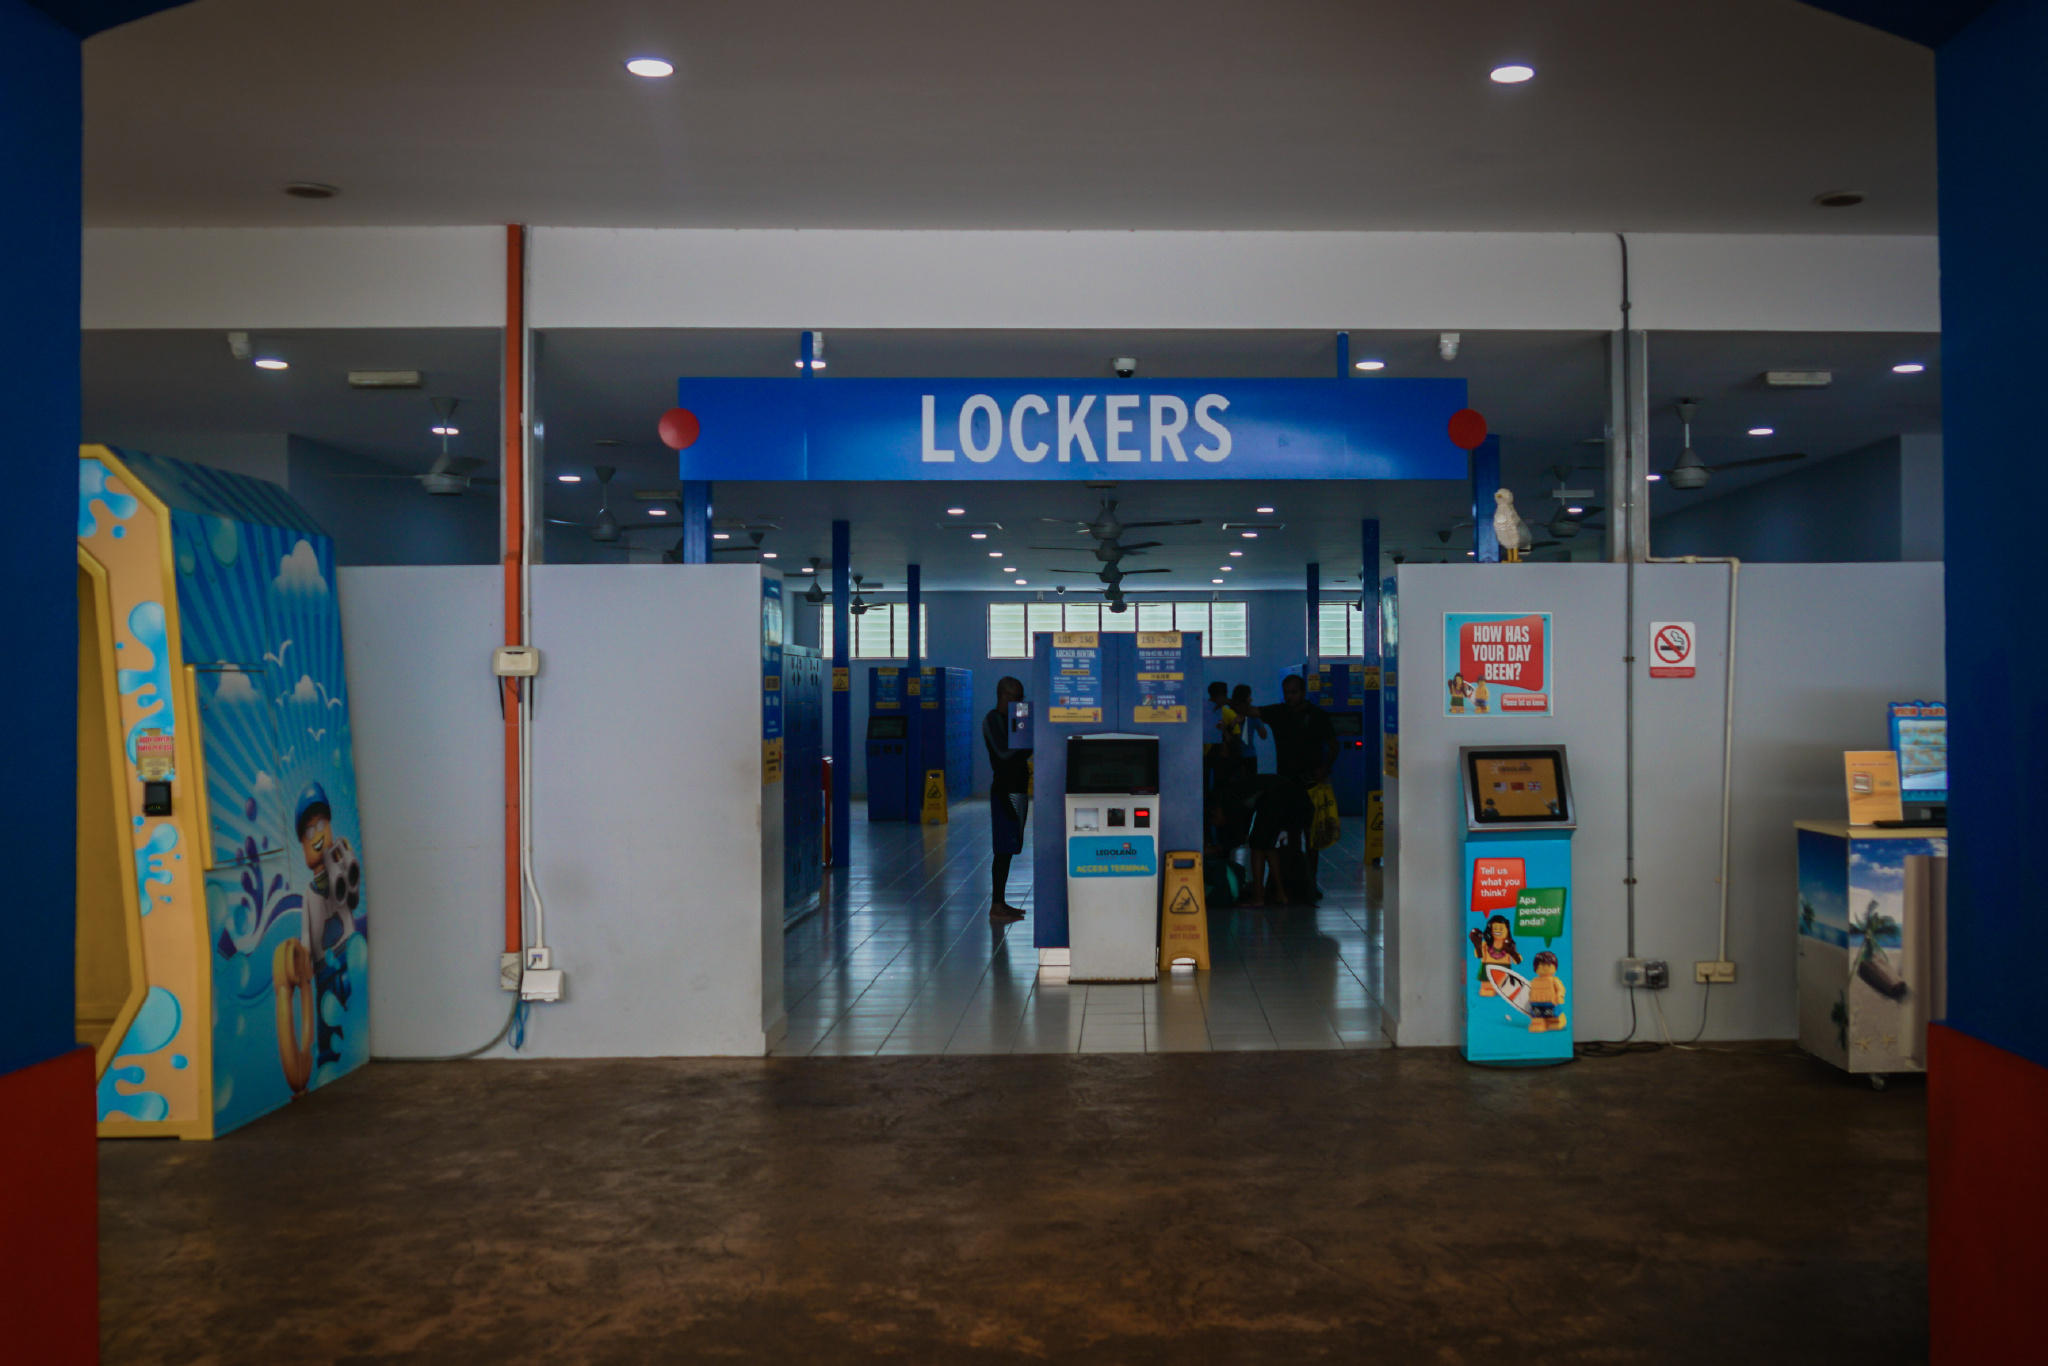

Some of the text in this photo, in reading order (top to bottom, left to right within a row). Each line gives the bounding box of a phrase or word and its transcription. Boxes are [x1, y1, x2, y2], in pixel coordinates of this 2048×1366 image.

[921, 393, 1232, 463] LOCKERS
[1473, 625, 1530, 643] HOW HAS
[1056, 649, 1096, 657] LOCKER RENTAL
[1471, 644, 1532, 662] YOUR DAY
[1485, 663, 1522, 681] BEEN?
[1503, 698, 1517, 706] Please
[1076, 864, 1150, 873] ACCESS TERMINAL
[1480, 867, 1495, 875] Tell
[1480, 878, 1520, 887] what you
[1480, 889, 1507, 897] think?
[1519, 896, 1536, 905] Apa
[1519, 907, 1561, 916] pendapat
[1519, 918, 1546, 926] anda?
[1173, 924, 1197, 932] CAUTION
